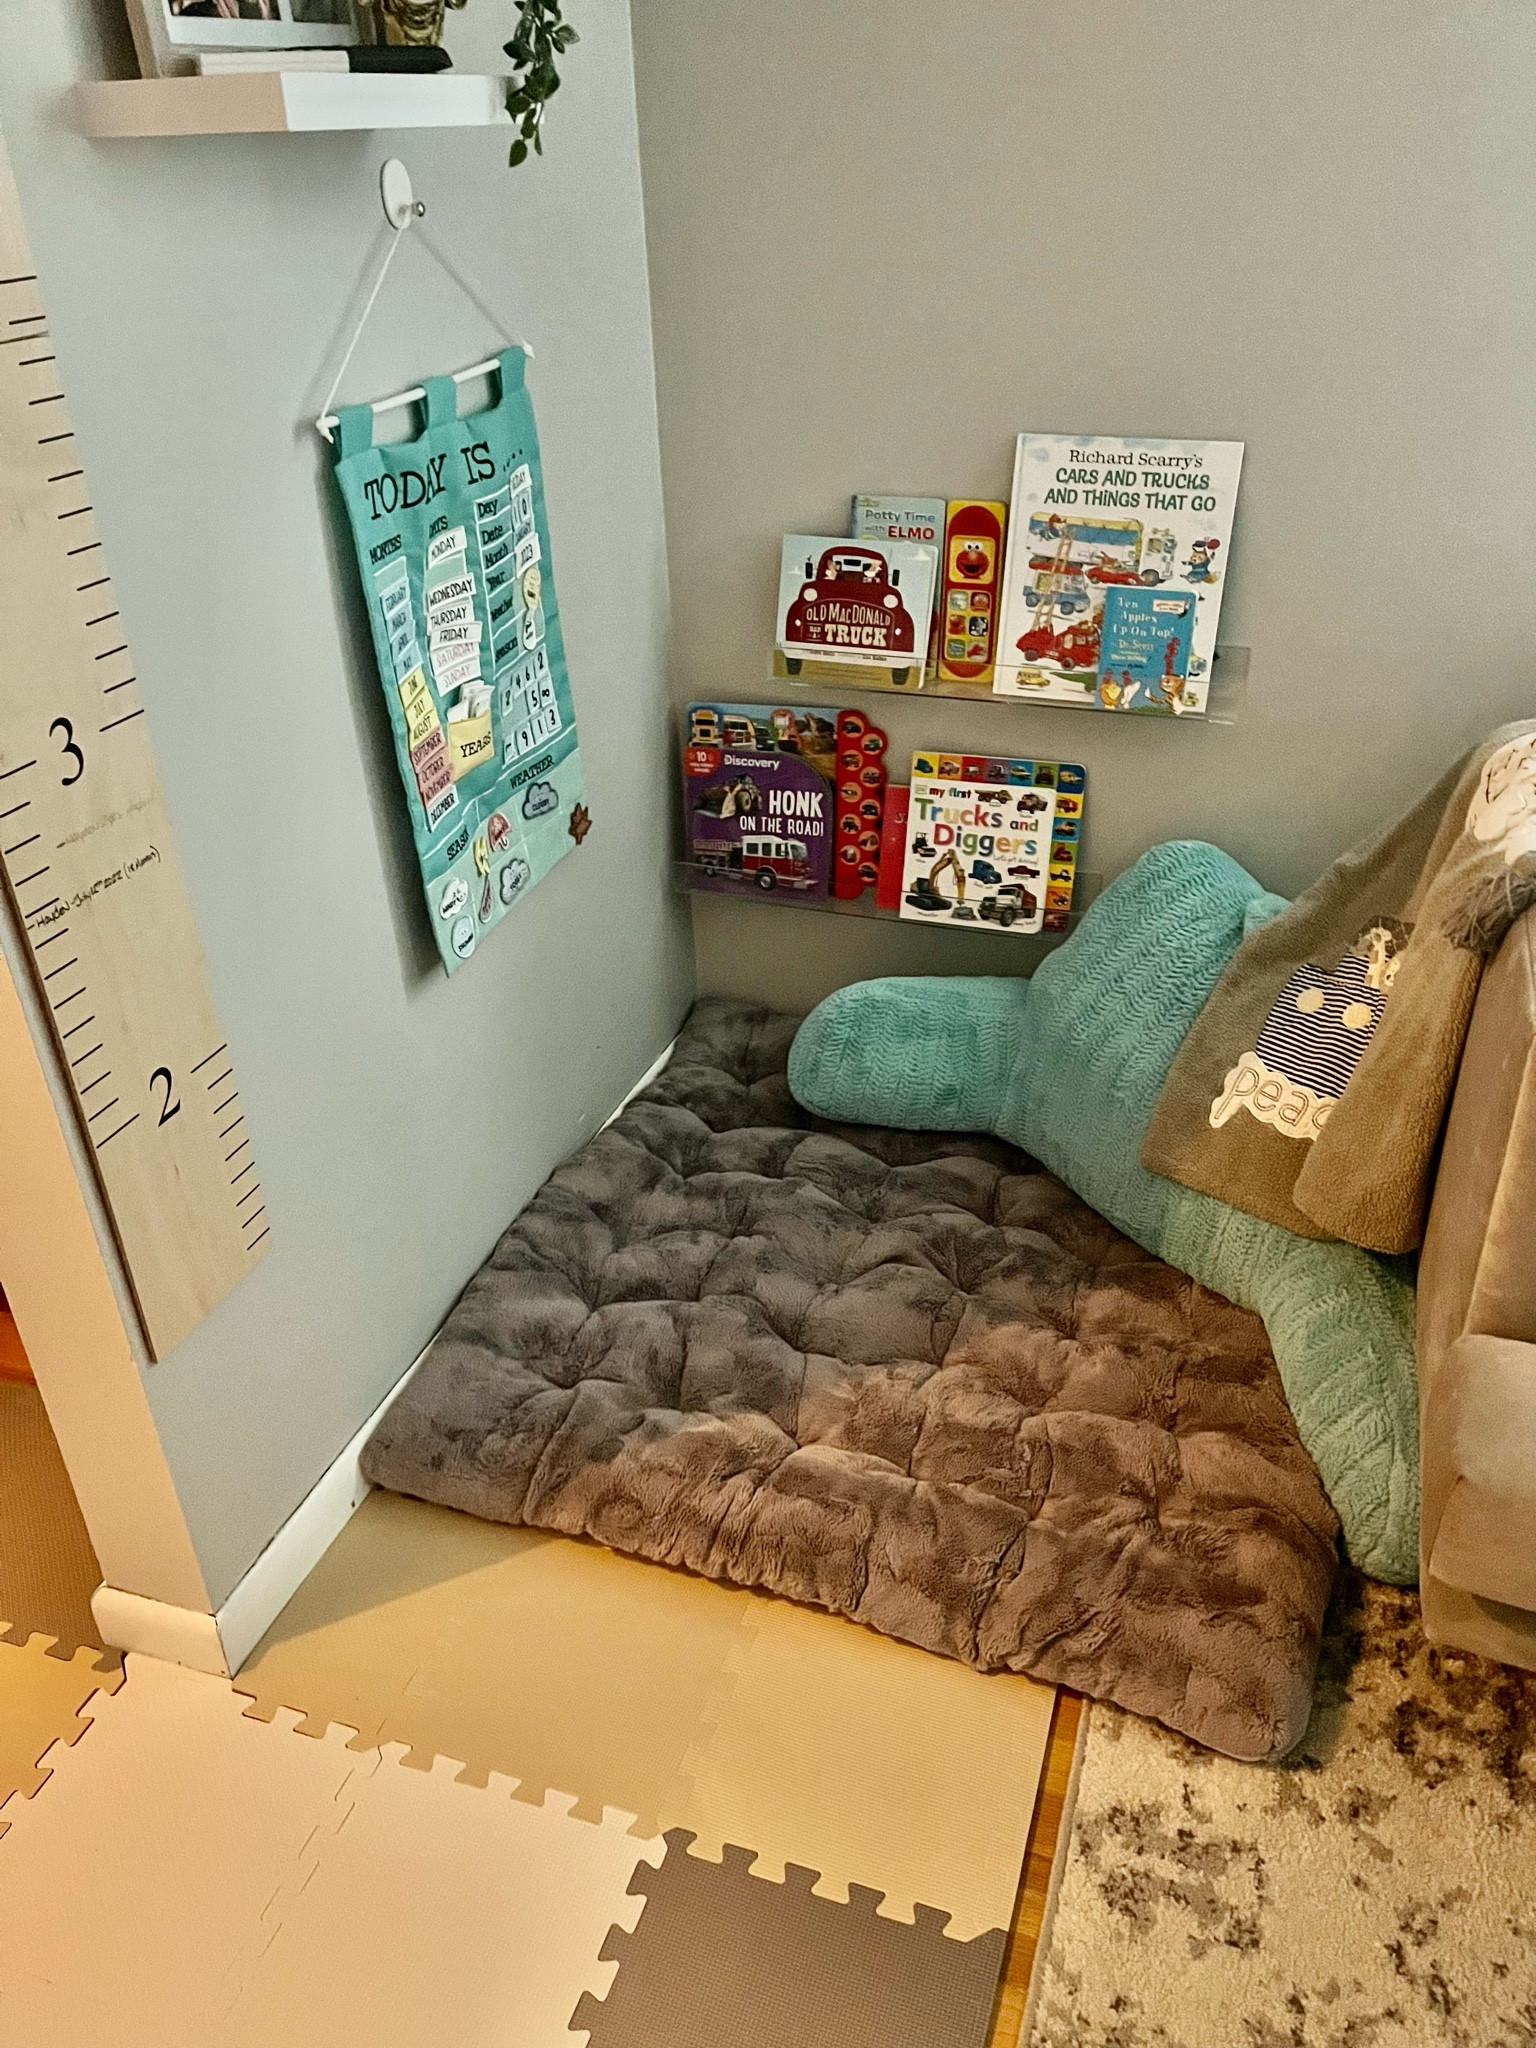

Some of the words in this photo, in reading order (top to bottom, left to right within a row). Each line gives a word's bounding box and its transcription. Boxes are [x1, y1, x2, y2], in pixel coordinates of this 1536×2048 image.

[1069, 449, 1133, 466] Richard
[1138, 453, 1203, 469] Scarry's
[364, 454, 447, 520] TODAY
[460, 441, 496, 485] IS
[1056, 468, 1098, 484] CARS
[1102, 470, 1138, 487] AND
[1142, 472, 1210, 490] TRUCKS
[478, 500, 498, 518] Day
[1044, 488, 1078, 505] AND
[1146, 492, 1188, 511] THAT
[1191, 495, 1217, 512] GO
[865, 509, 901, 523] Potty
[904, 511, 936, 523] Time
[482, 523, 503, 546] Date
[864, 524, 885, 532] with
[887, 525, 935, 540] ELMO
[429, 579, 473, 606] WEDNESDAY
[1118, 596, 1139, 609] Ten
[431, 606, 467, 627] THURSDAY
[806, 604, 827, 623] OLD
[1122, 610, 1158, 625] Apples
[440, 627, 469, 643] FRIDAY
[824, 623, 888, 648] TRUCK
[1113, 623, 1128, 636] Up
[1131, 625, 1147, 637] On
[1150, 626, 1175, 639] Top!
[436, 642, 475, 669] SATURDAY
[525, 666, 531, 682] 6
[537, 651, 545, 672] 2
[444, 664, 471, 688] SUNDAY
[531, 690, 538, 708] 5
[521, 731, 529, 747] 9
[537, 718, 543, 735] 1
[549, 709, 556, 726] 3
[49, 717, 84, 786] 3
[460, 731, 491, 758] YEARS
[696, 751, 706, 762] 10
[724, 754, 780, 771] Discovery
[509, 754, 555, 789] WEATHER
[769, 789, 823, 818] HONK
[929, 786, 945, 798] my
[948, 786, 972, 799] first
[914, 797, 1003, 828] Trucks
[1009, 819, 1038, 832] and
[739, 815, 756, 832] ON
[761, 816, 782, 833] THE
[787, 818, 824, 837] ROAD!
[933, 823, 1038, 857] Diggers
[149, 1066, 181, 1127] 2
